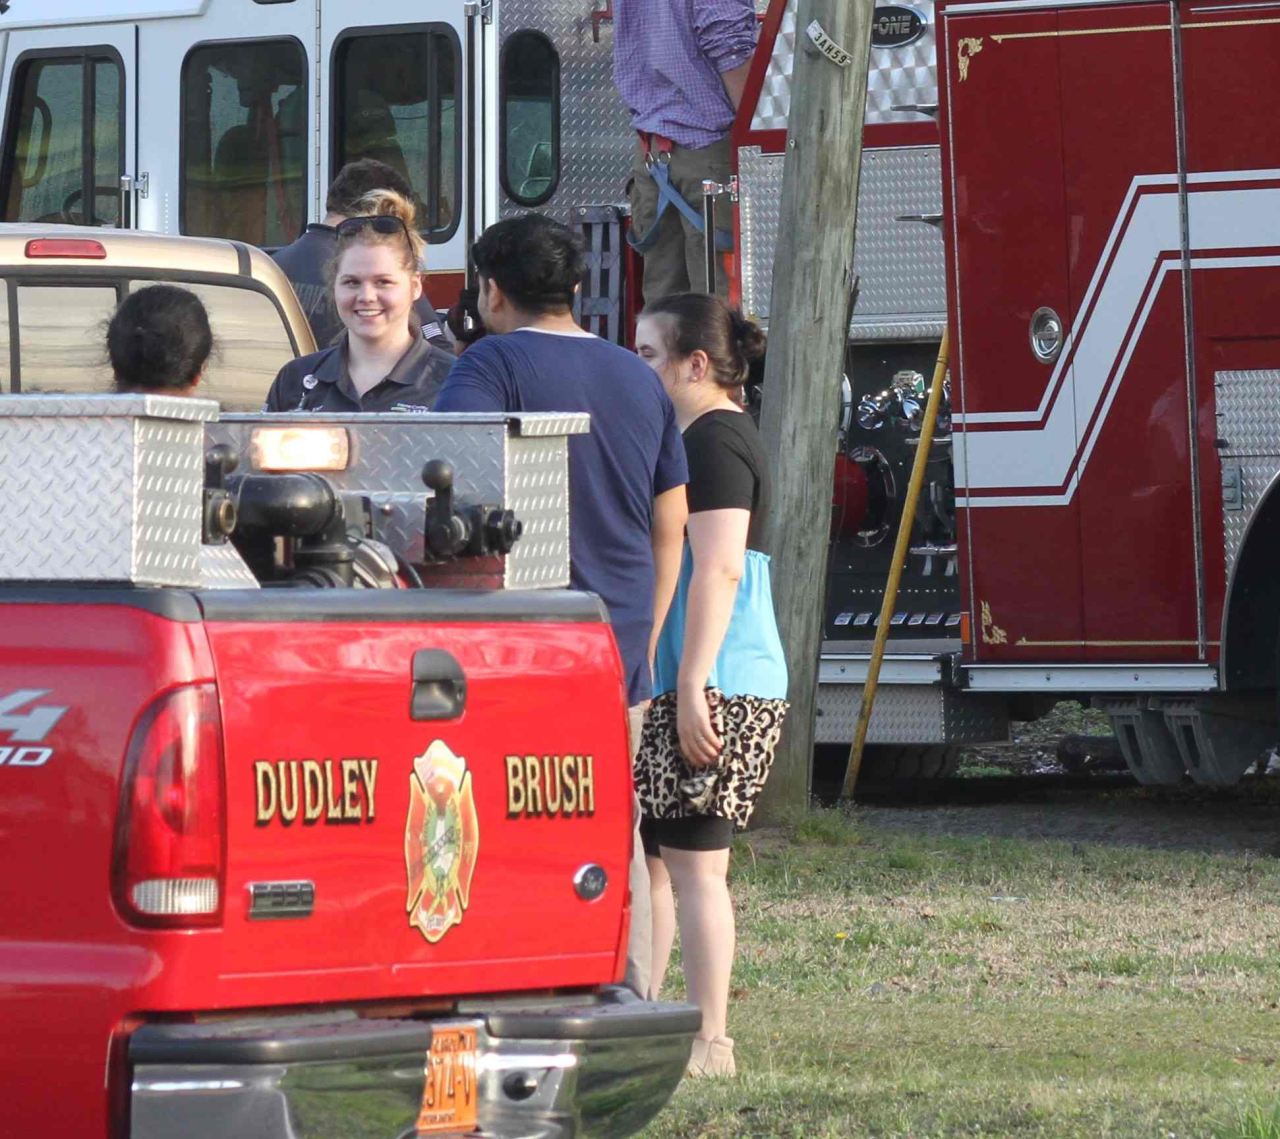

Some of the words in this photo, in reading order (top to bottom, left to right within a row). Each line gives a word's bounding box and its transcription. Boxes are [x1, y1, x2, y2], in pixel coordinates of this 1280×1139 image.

[813, 31, 848, 65] 3AH59
[254, 758, 379, 823] DUDLEY
[505, 755, 595, 818] BRUSH
